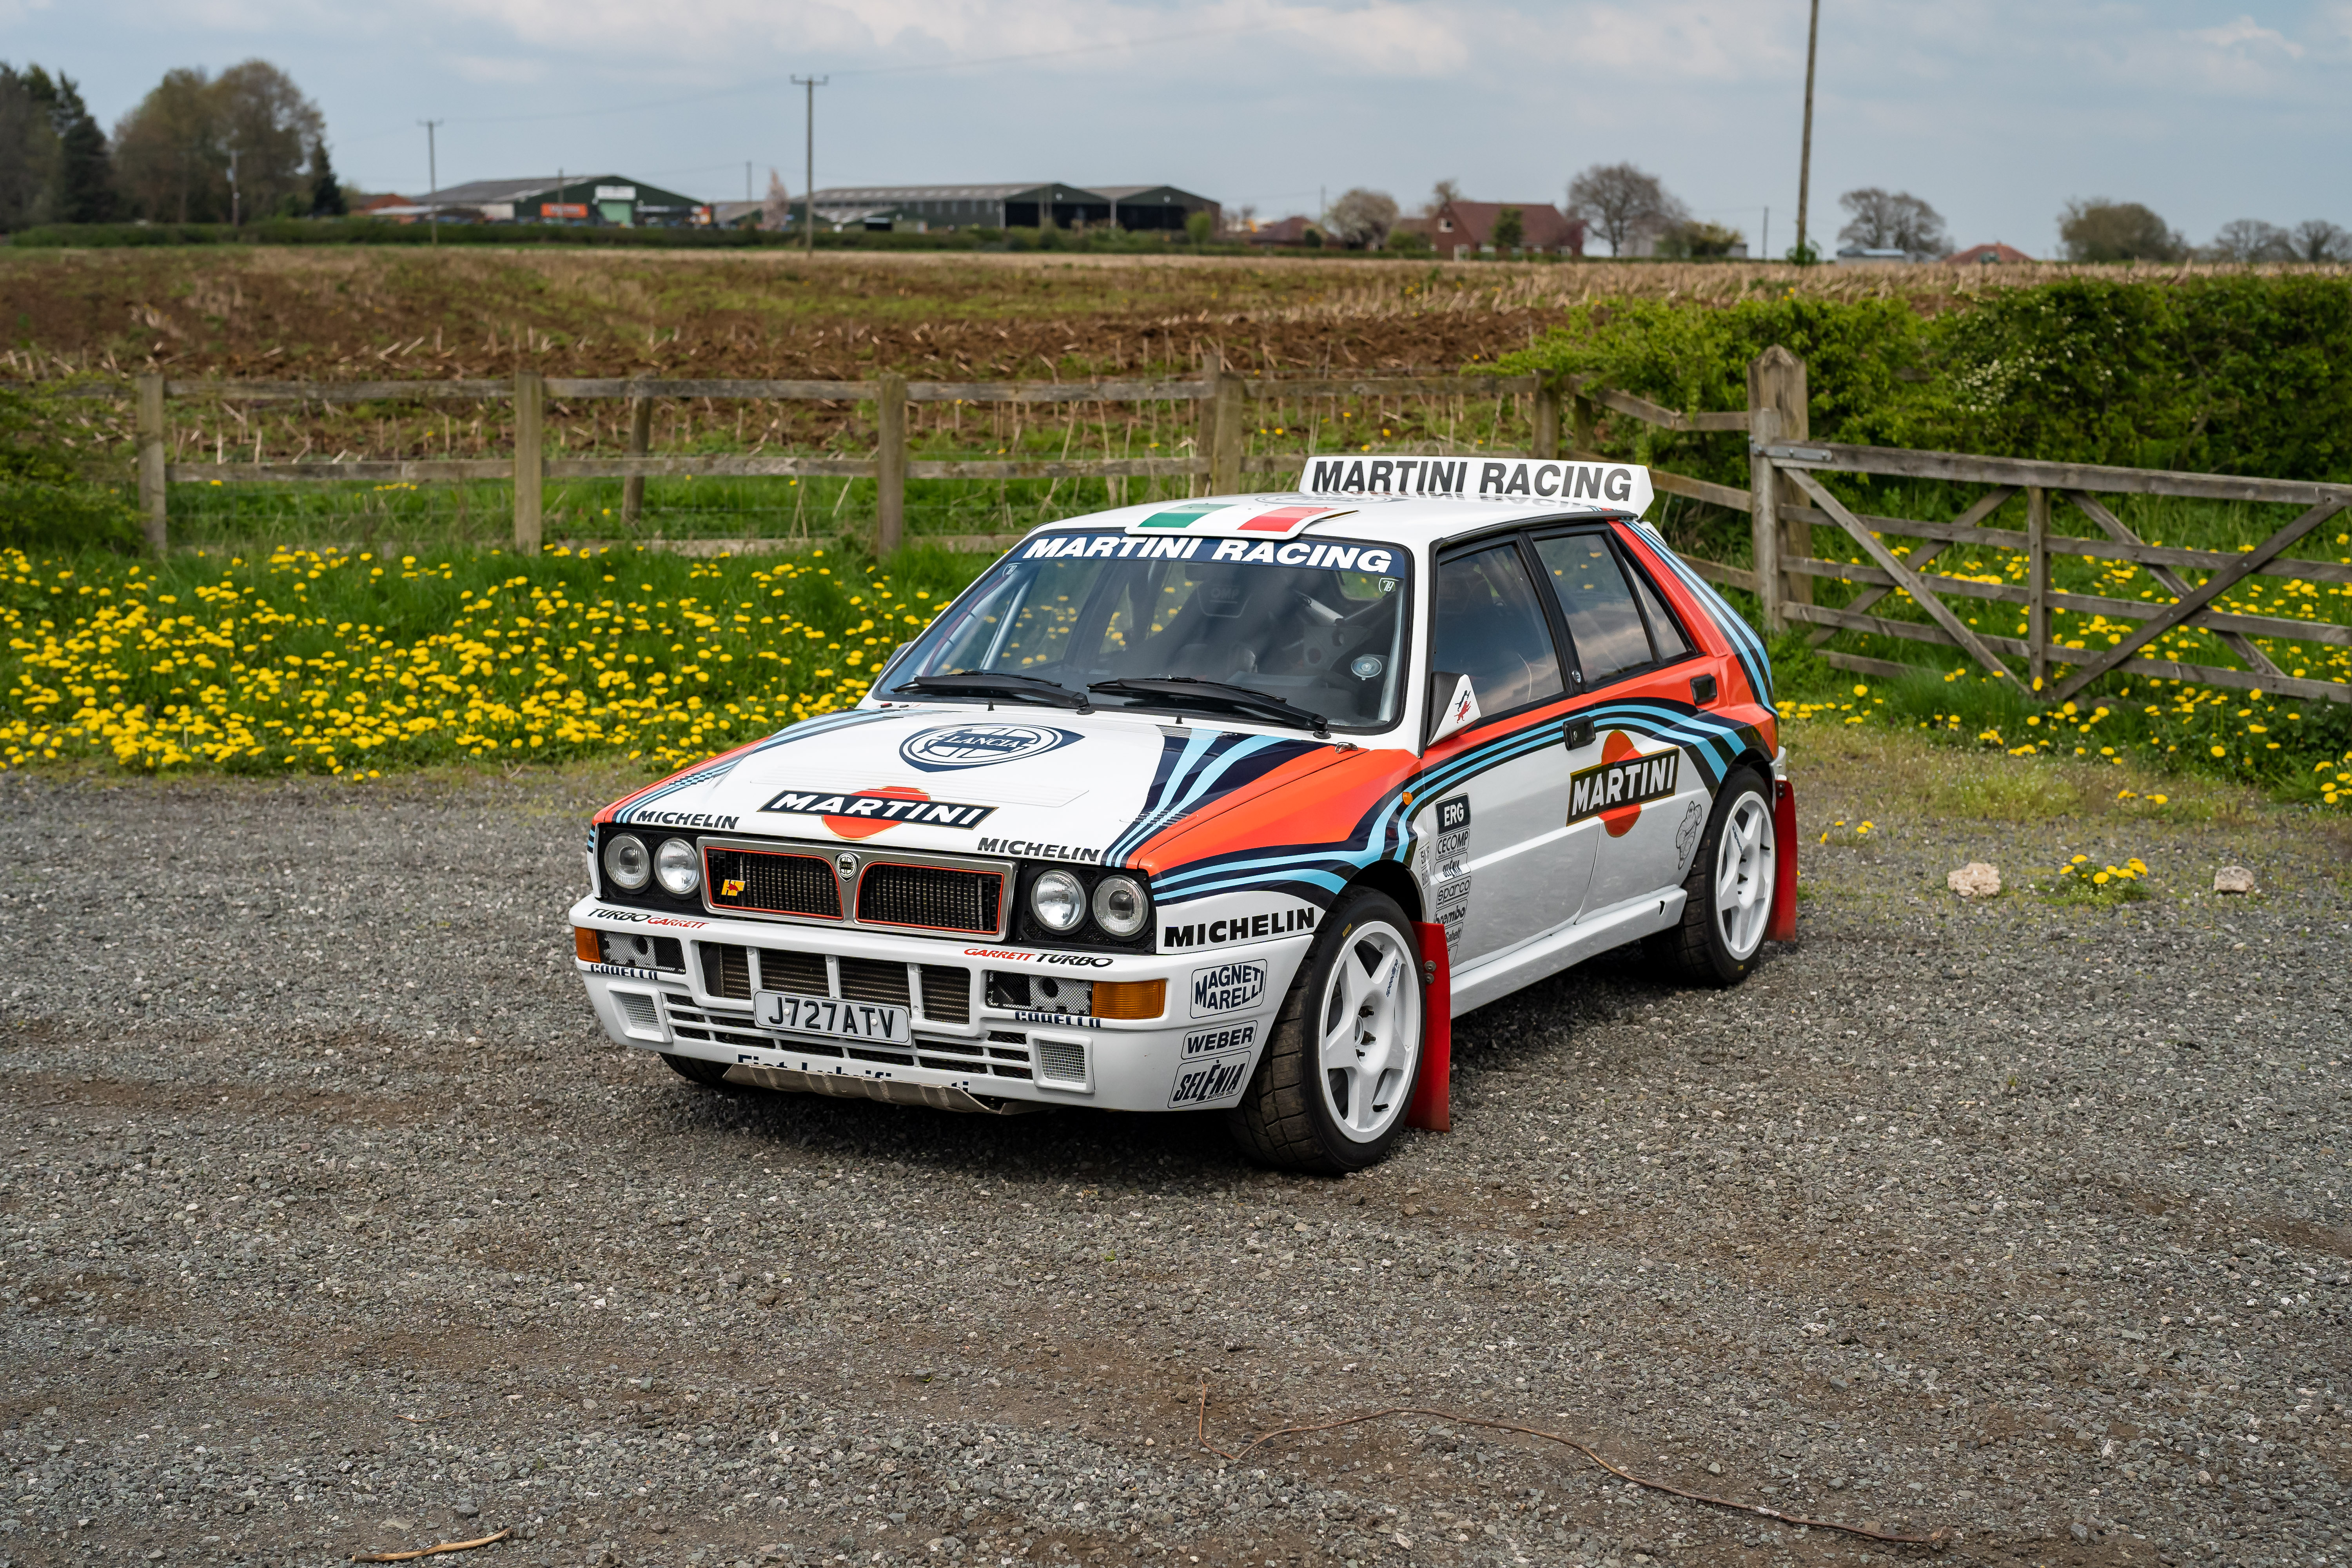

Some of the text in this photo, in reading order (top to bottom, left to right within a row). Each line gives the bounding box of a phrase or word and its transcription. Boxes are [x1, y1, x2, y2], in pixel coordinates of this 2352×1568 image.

[1312, 461, 1632, 501] MARTINI RACING
[1022, 537, 1392, 573] MARTINI RACING
[944, 736, 1020, 748] LANCIA
[1572, 755, 1675, 816] MARTINI
[637, 811, 740, 829] MICHELIN
[771, 793, 984, 825] MARTINI
[1444, 802, 1464, 827] ERG
[977, 837, 1101, 862] MICHELIN
[1437, 831, 1469, 855] CECOMP
[1437, 879, 1470, 905] sparco
[588, 909, 709, 929] TURBO GARRETT
[1163, 907, 1314, 947] MICHELIN
[1434, 906, 1465, 925] brembo
[964, 949, 1114, 967] GARRETT TURBO
[1195, 965, 1264, 998] MAGNETI
[1195, 982, 1264, 1010] MARELLI
[768, 996, 895, 1038] J727ATV
[1188, 1026, 1254, 1054] WEBER
[1207, 1092, 1225, 1100] MOTOR
